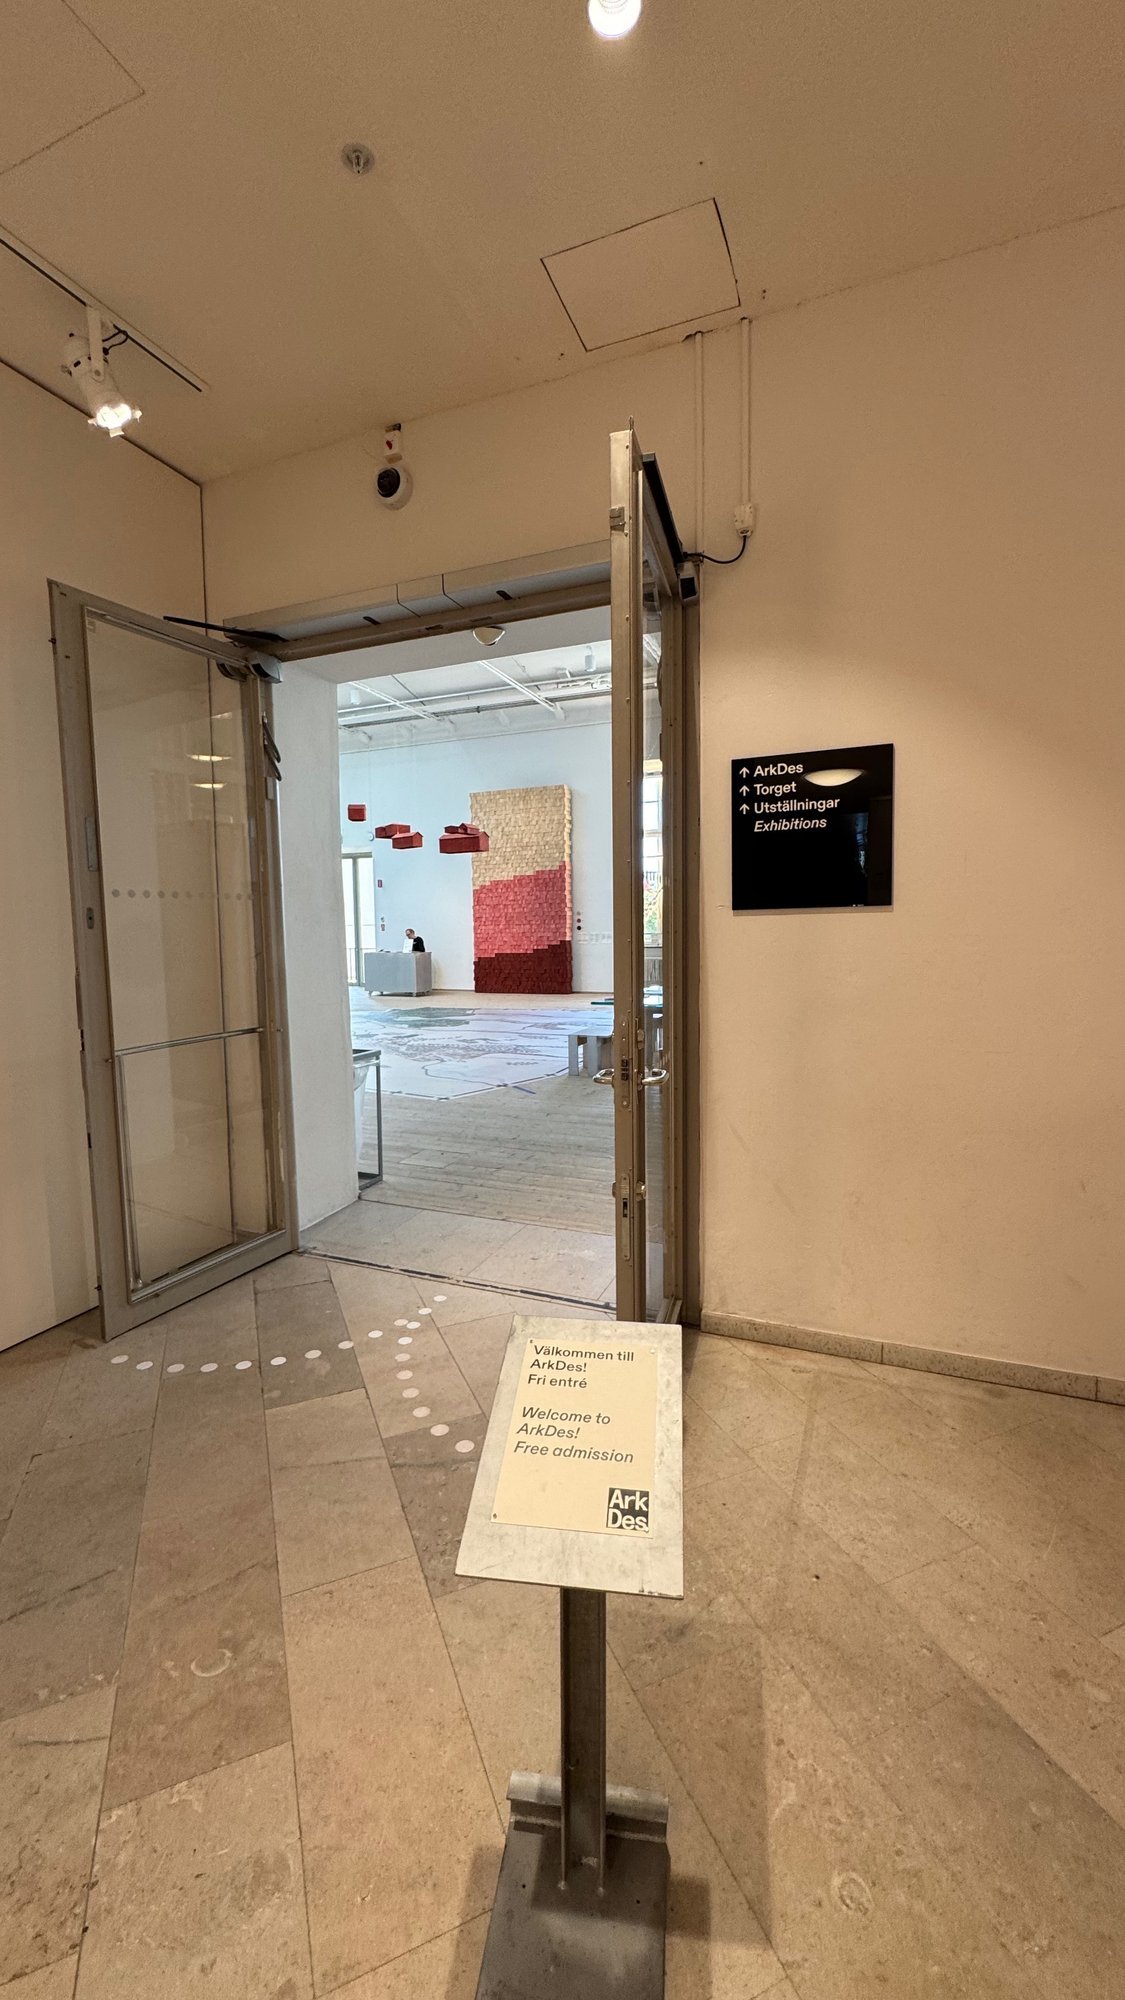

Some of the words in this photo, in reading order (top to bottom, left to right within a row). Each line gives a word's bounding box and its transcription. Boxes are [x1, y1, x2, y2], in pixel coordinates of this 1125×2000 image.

[753, 763, 803, 777] ArkDes
[753, 781, 797, 797] Torget
[754, 798, 840, 814] Utställningar
[754, 818, 827, 832] Exhibitions
[534, 1344, 614, 1361] Välkommen
[617, 1350, 635, 1362] till
[530, 1358, 587, 1373] ArkDes!
[527, 1374, 546, 1386] Fri
[550, 1376, 588, 1389] entré
[522, 1406, 592, 1423] Welcome
[595, 1412, 611, 1425] to
[516, 1423, 580, 1439] ArkDes!
[513, 1441, 548, 1456] Free
[552, 1445, 634, 1463] admission
[609, 1489, 648, 1511] Ark
[607, 1508, 648, 1531] Des
